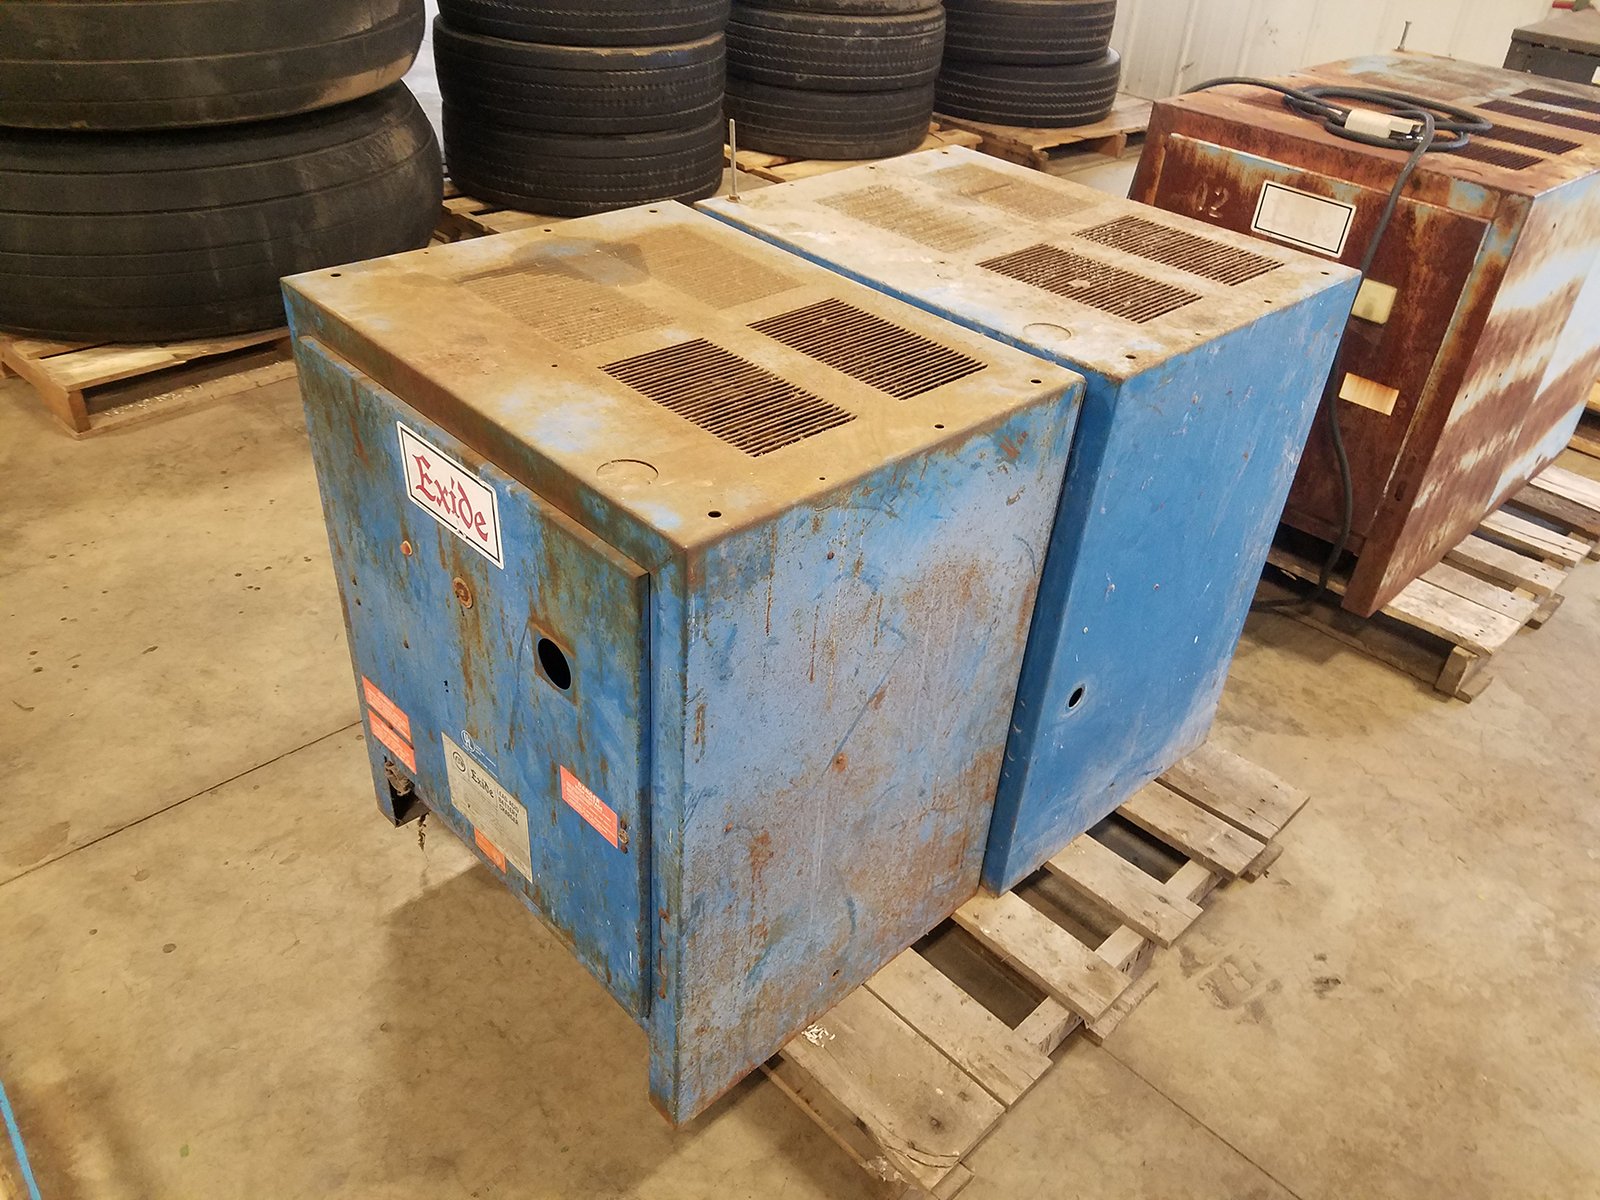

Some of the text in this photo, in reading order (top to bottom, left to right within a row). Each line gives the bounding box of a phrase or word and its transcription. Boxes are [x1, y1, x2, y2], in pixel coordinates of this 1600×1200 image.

[412, 454, 489, 542] Exide
[470, 768, 494, 799] Exide
[498, 796, 518, 818] BATTERY
